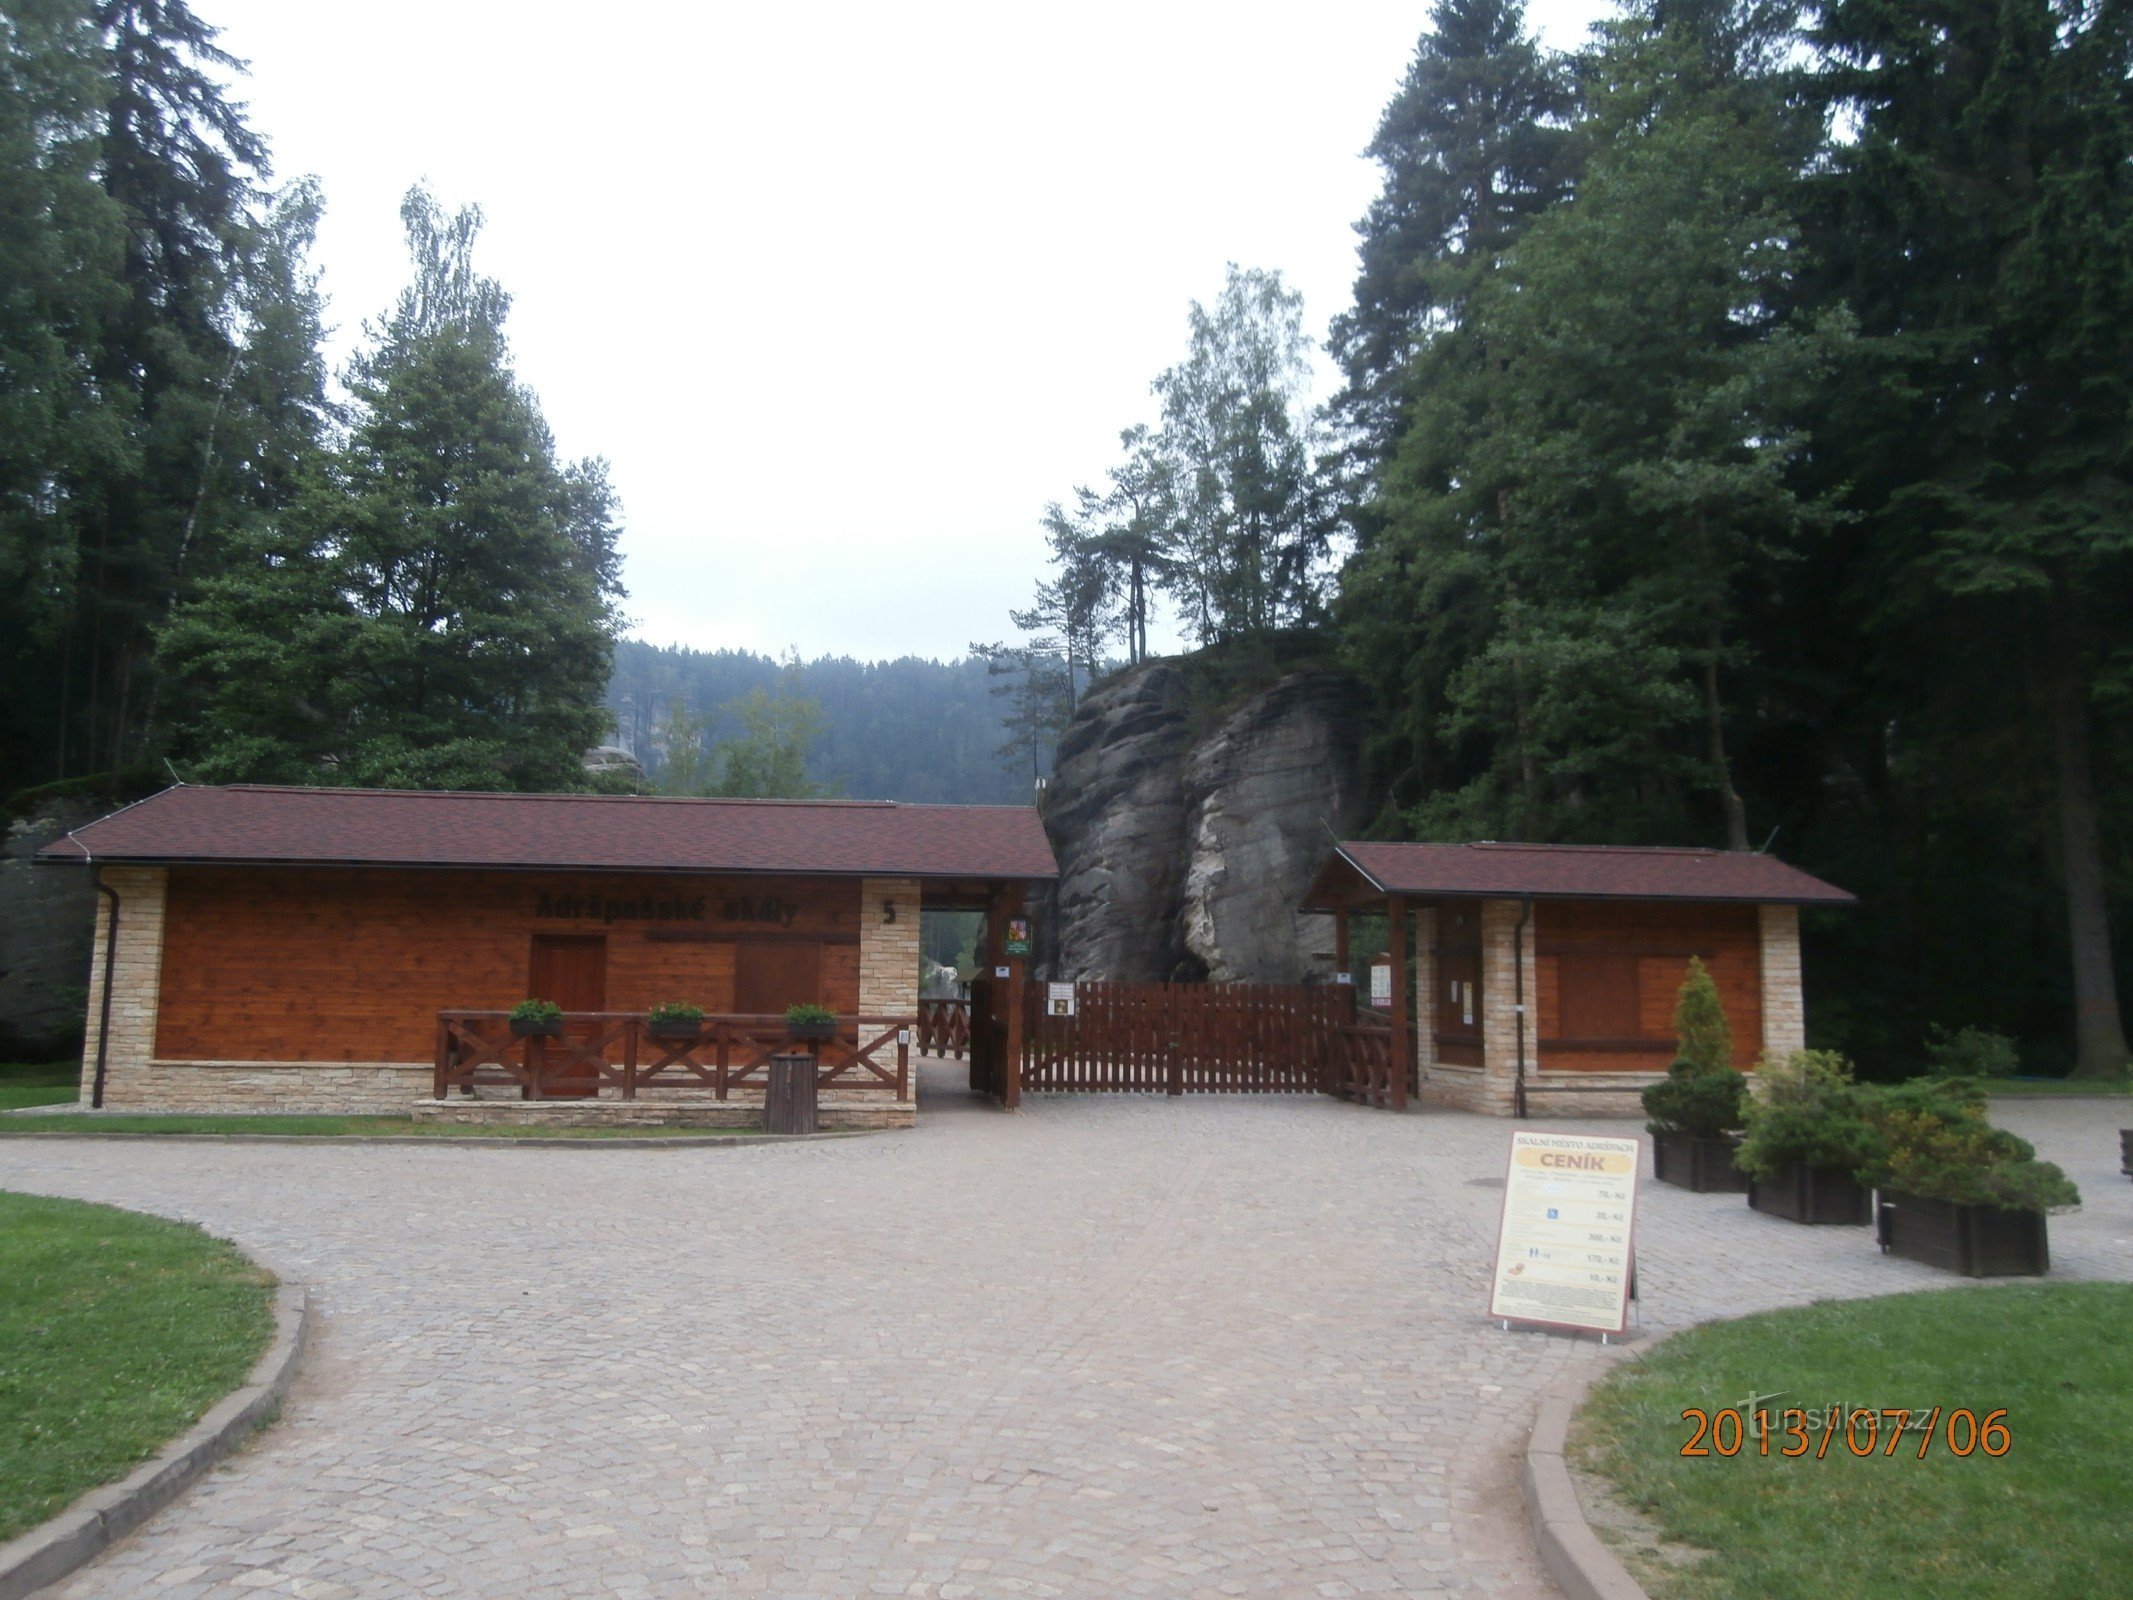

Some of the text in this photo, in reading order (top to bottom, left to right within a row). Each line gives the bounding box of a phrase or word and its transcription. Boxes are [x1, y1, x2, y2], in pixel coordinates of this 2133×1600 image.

[722, 893, 798, 927] skály
[882, 900, 897, 925] 5
[1539, 1152, 1605, 1171] CENÍK
